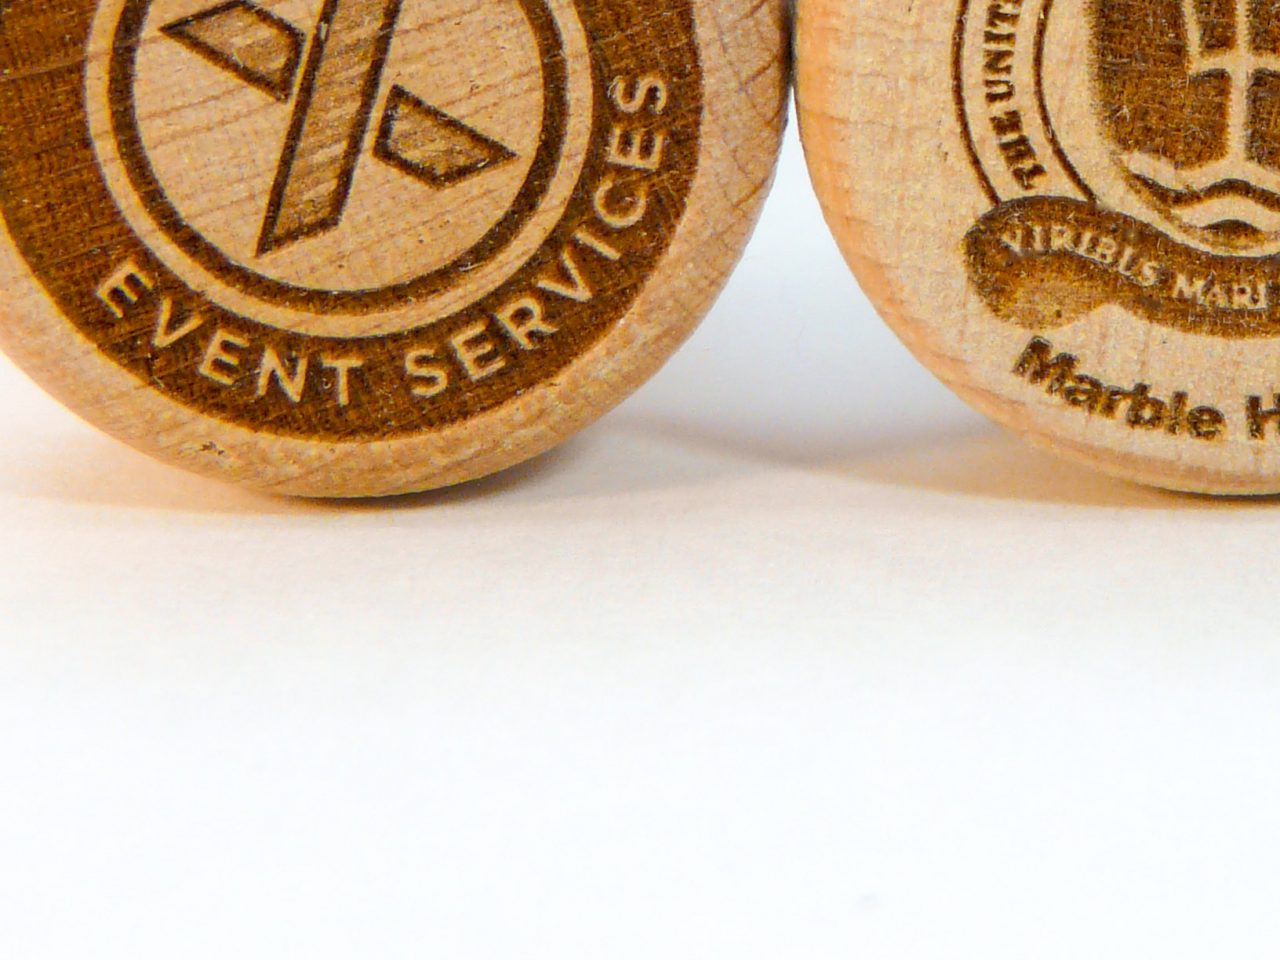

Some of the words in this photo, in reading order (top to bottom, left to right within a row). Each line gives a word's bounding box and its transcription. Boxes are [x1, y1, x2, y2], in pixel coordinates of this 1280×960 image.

[989, 110, 1047, 190] THE
[95, 257, 363, 404] EVENT
[405, 71, 669, 398] SERVICES
[1171, 272, 1268, 310] MARI
[1012, 335, 1227, 439] Marble
